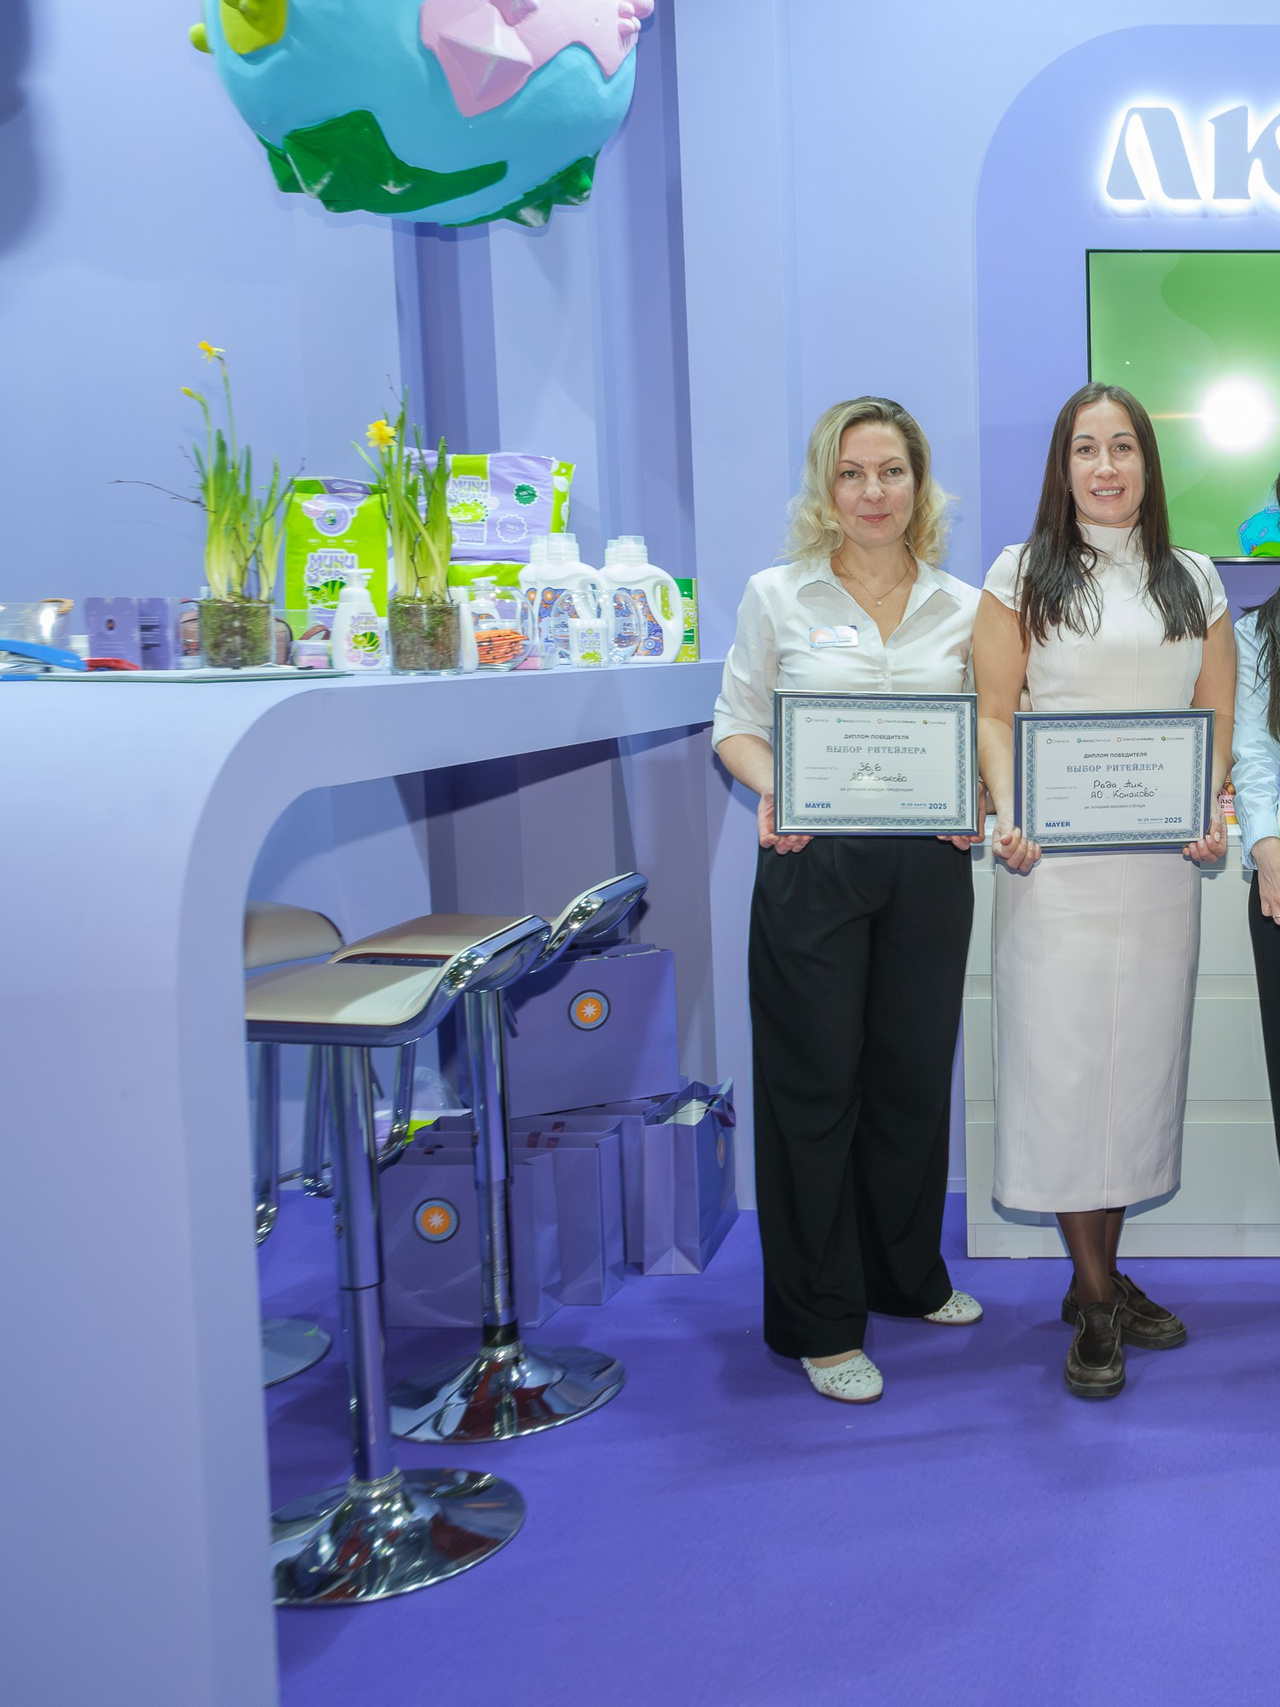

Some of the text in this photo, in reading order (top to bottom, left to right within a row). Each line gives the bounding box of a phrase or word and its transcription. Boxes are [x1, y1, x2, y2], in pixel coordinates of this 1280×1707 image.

[826, 745, 927, 755] ВЫБОР РИТЕЙЛЕРА
[1066, 763, 1164, 773] ВЫБОР РИТЕЙЛЕРА
